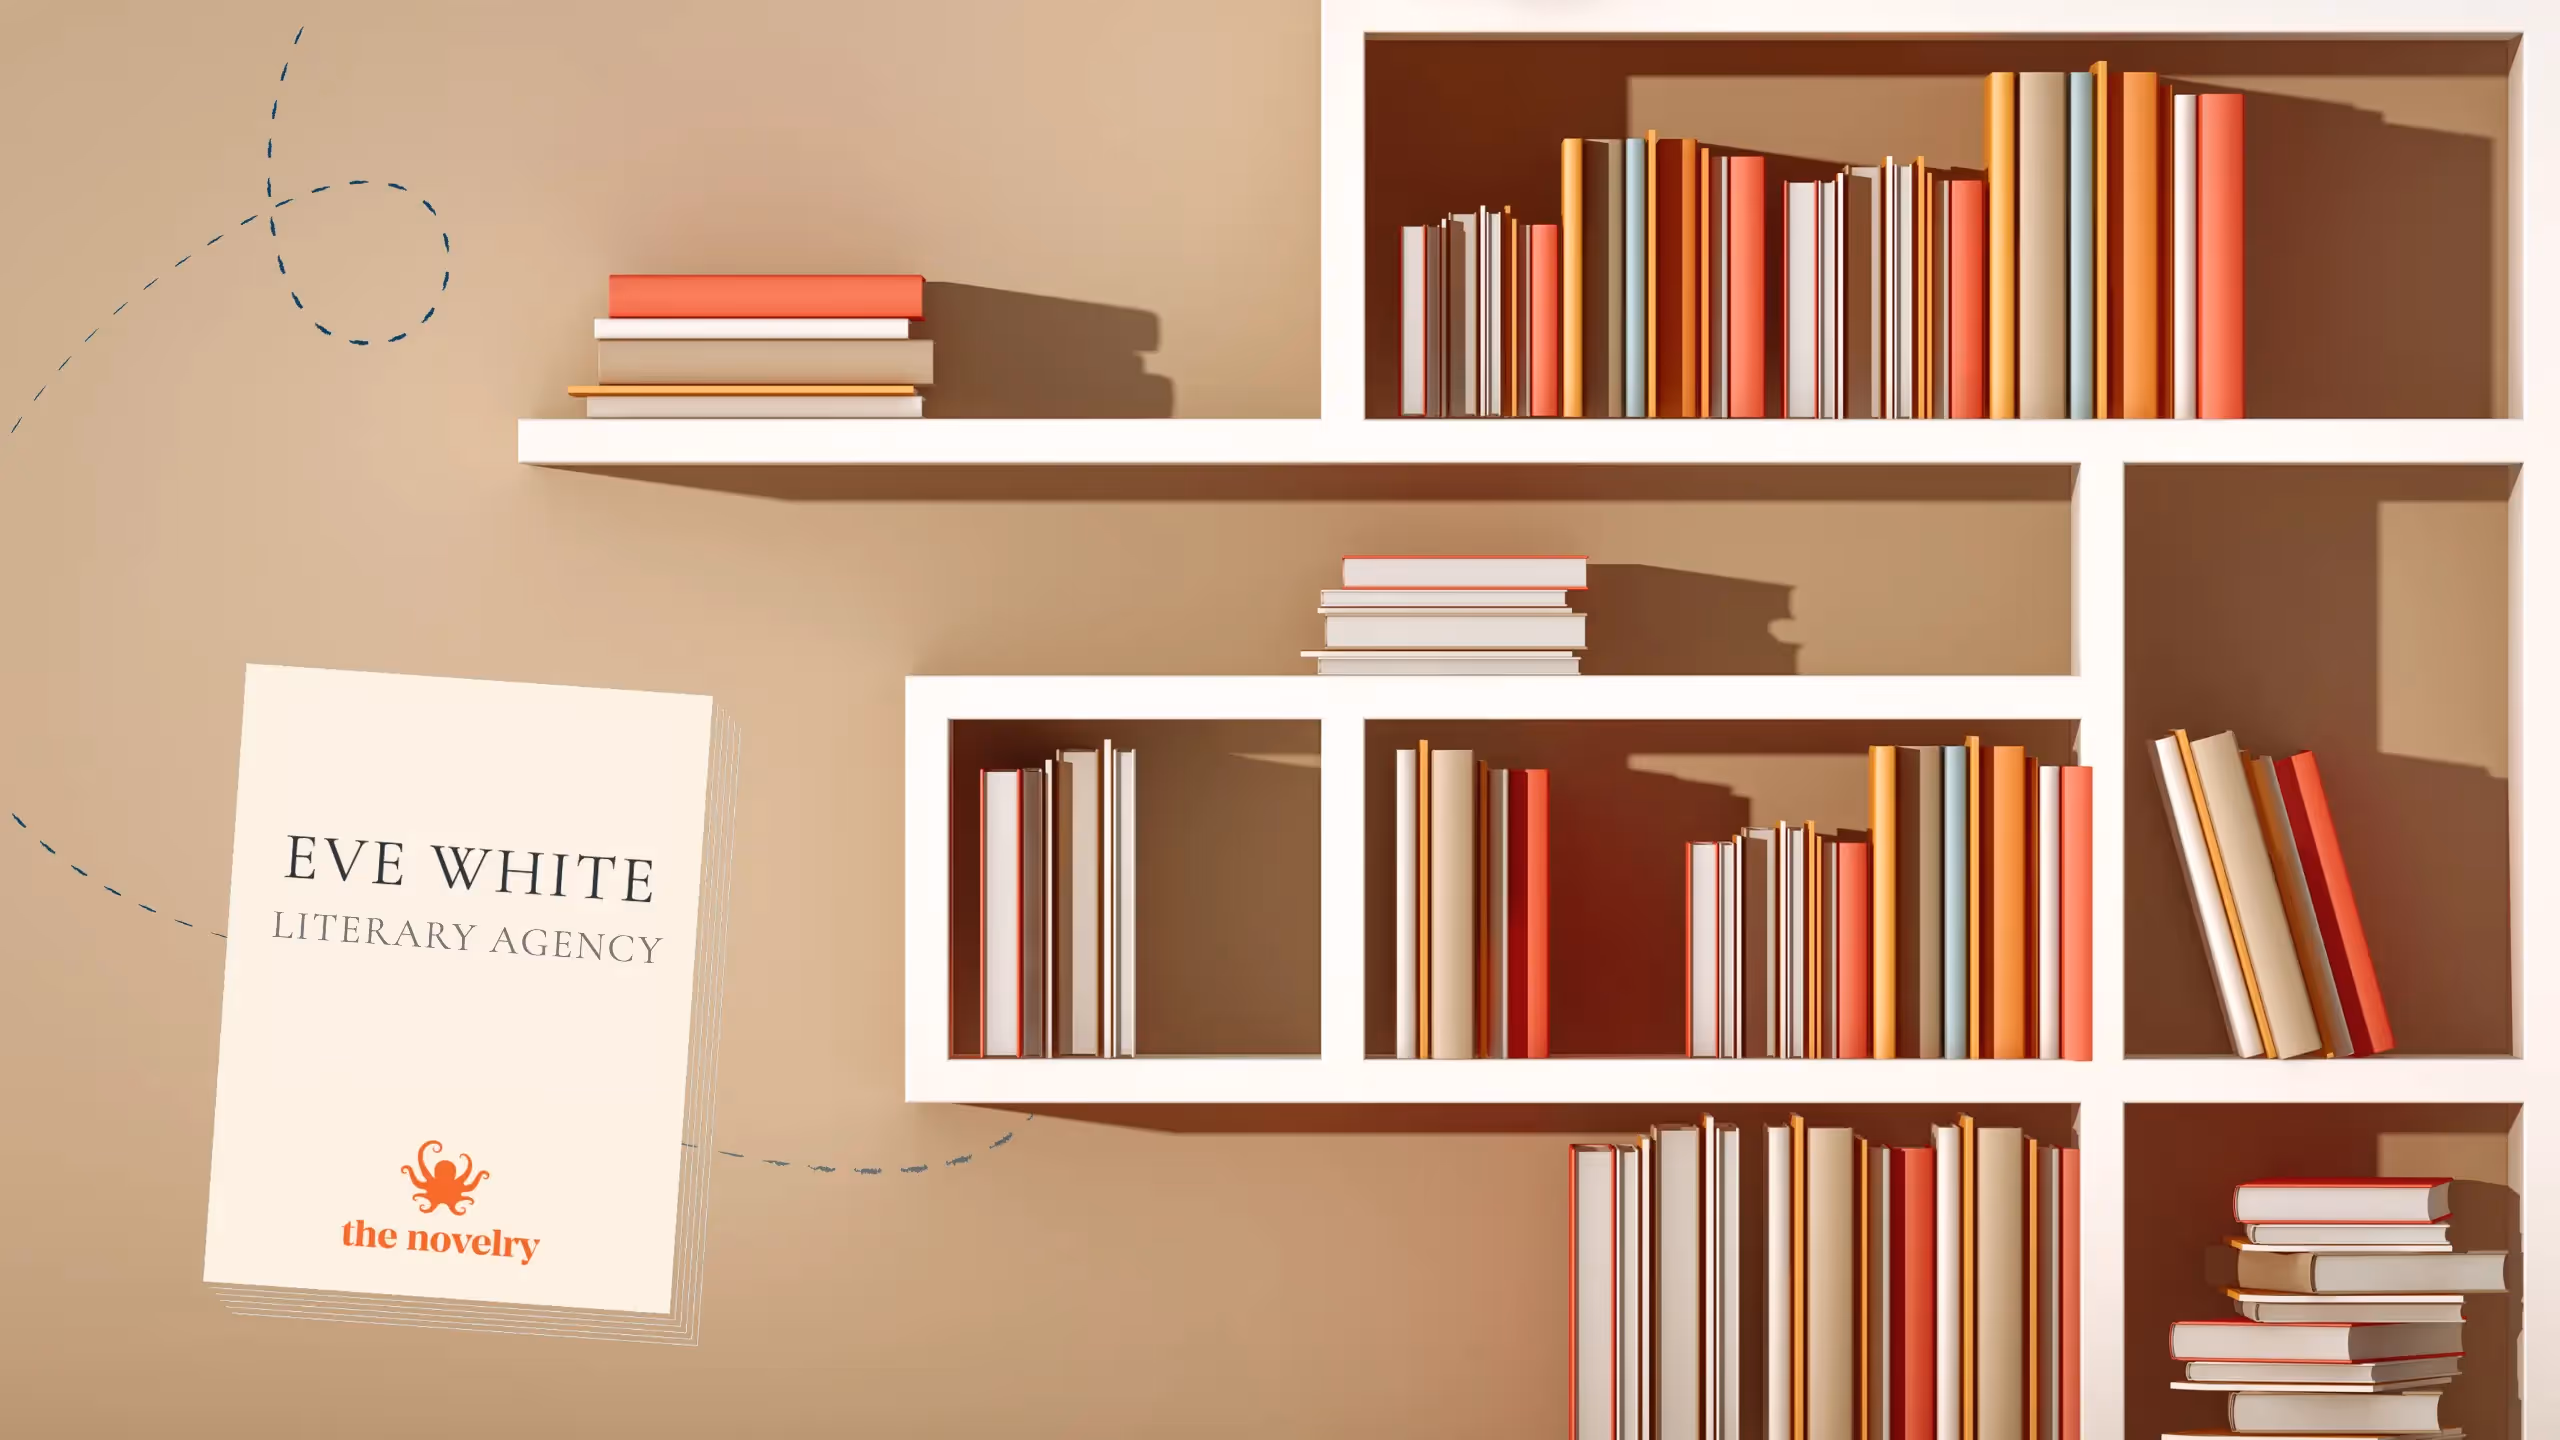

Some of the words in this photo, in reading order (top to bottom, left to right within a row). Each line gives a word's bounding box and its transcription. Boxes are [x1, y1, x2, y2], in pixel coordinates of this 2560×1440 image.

[283, 834, 404, 886] EVE
[430, 844, 654, 903] WHITE
[272, 911, 477, 951] LITERARY
[488, 926, 664, 964] AGENCY
[341, 1219, 398, 1250] the
[406, 1228, 541, 1266] novelry
